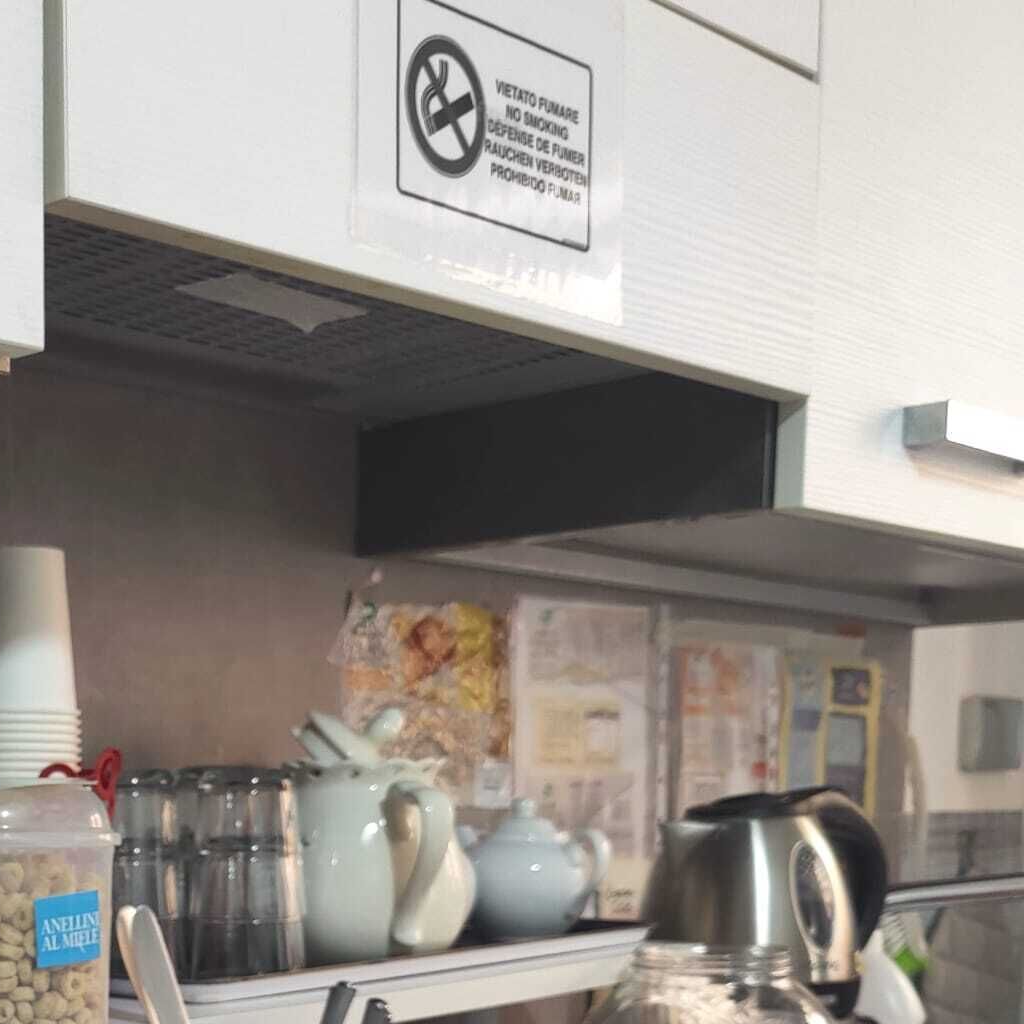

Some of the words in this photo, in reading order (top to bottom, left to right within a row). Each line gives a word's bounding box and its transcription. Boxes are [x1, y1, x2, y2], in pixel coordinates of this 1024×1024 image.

[496, 78, 536, 108] VIETATO
[539, 96, 579, 125] FUMARE
[506, 103, 521, 122] NO
[524, 110, 569, 141] SMOKING
[484, 138, 534, 168] RAUCHEN
[536, 157, 588, 187] VERBOTEN
[536, 137, 550, 154] DE
[552, 143, 585, 168] FUMER
[490, 162, 546, 194] PROHIBIDO
[548, 182, 581, 206] FUMAR
[41, 935, 62, 952] AL
[63, 927, 100, 949] MIELE
